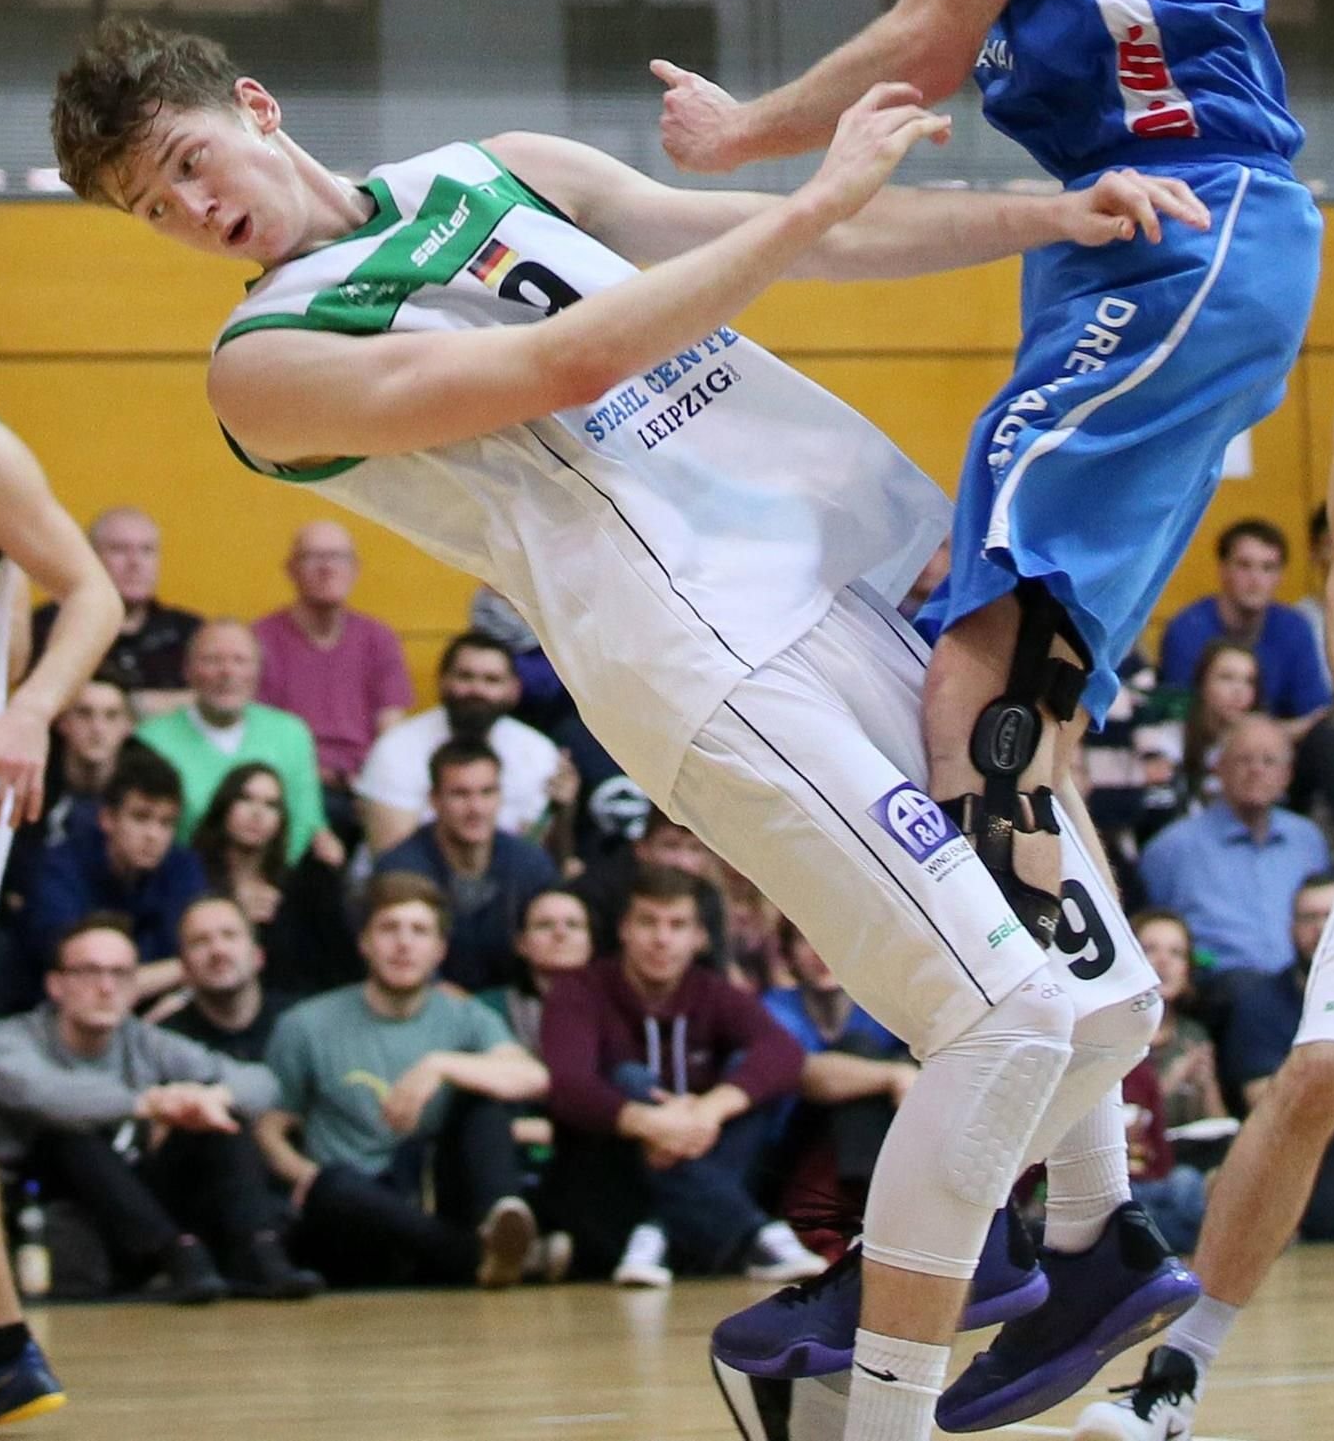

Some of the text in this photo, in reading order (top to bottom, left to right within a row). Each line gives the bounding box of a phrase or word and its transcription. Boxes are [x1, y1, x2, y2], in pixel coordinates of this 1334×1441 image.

[410, 193, 471, 268] saller
[584, 385, 650, 443] STAHL
[637, 367, 733, 450] LEIPZIG
[1054, 879, 1116, 981] 9
